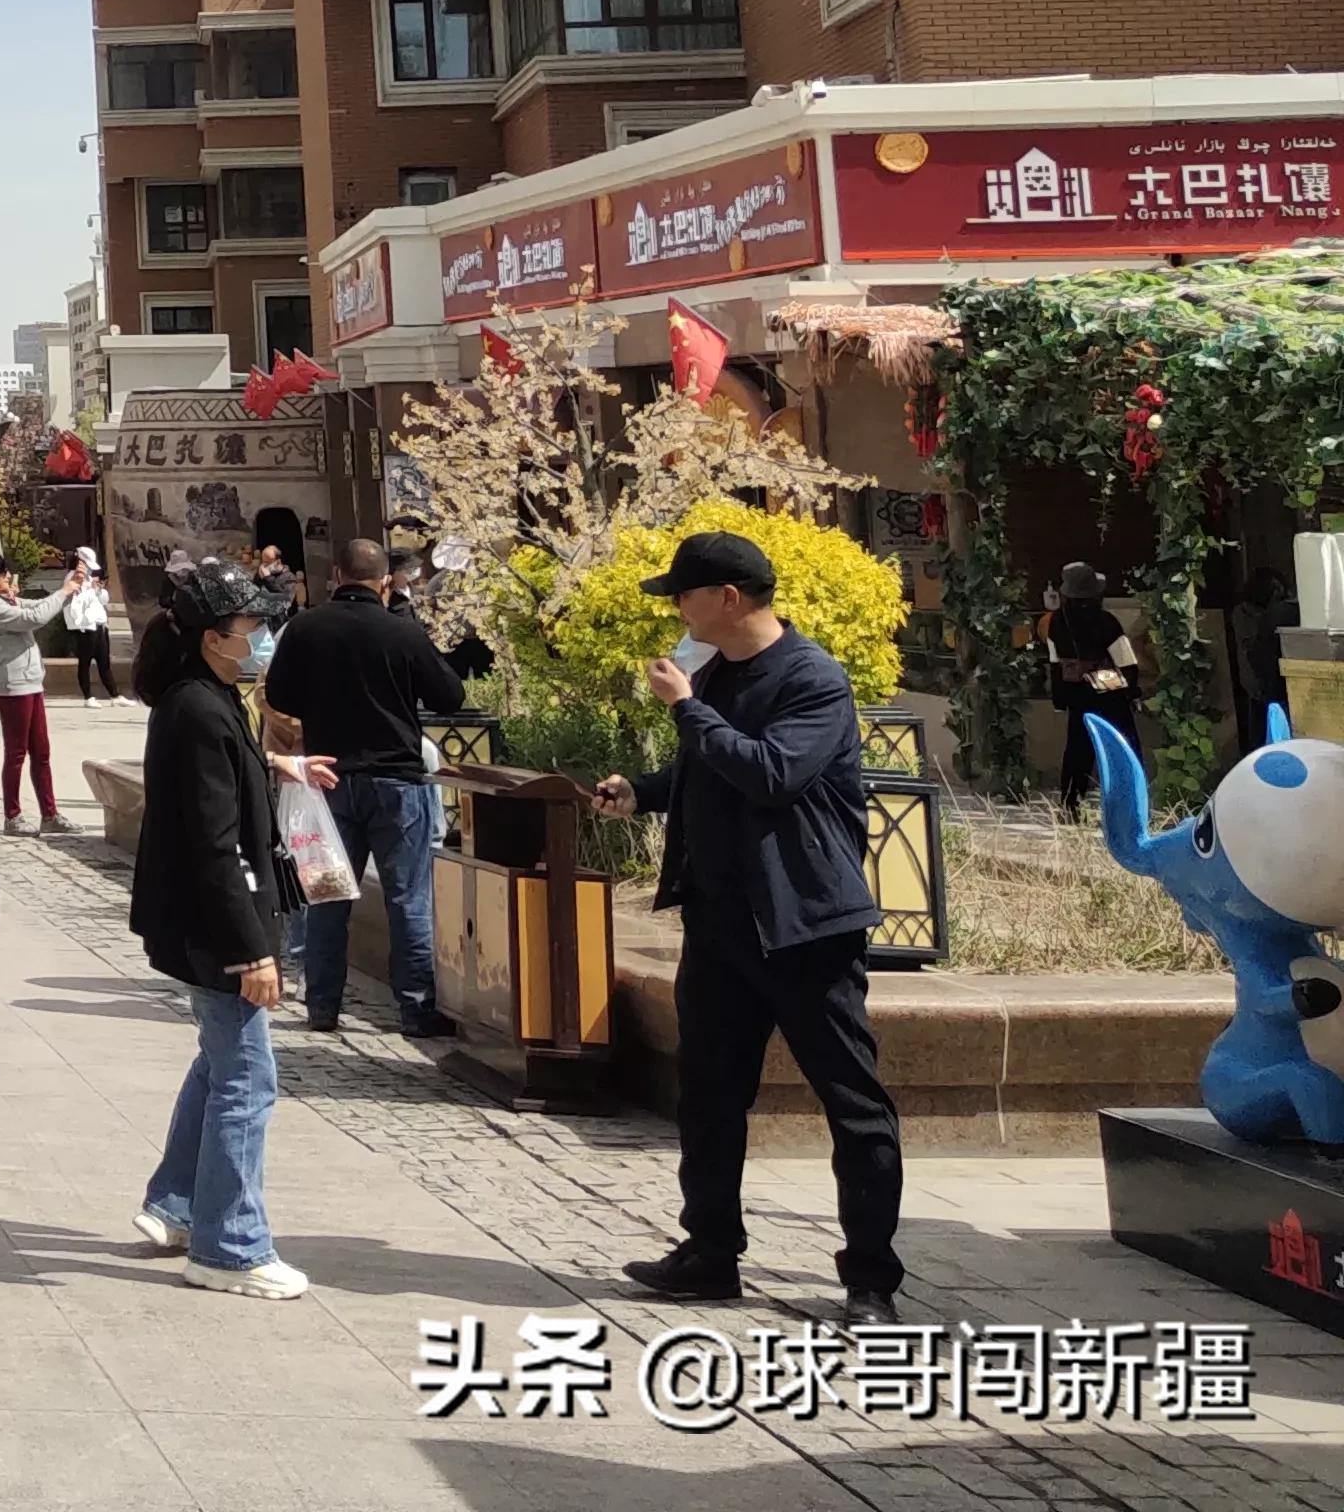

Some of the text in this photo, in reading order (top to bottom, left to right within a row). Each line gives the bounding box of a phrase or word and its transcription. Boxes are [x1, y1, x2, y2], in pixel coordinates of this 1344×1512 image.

[1137, 204, 1329, 221] Grand Bazaar Nang
